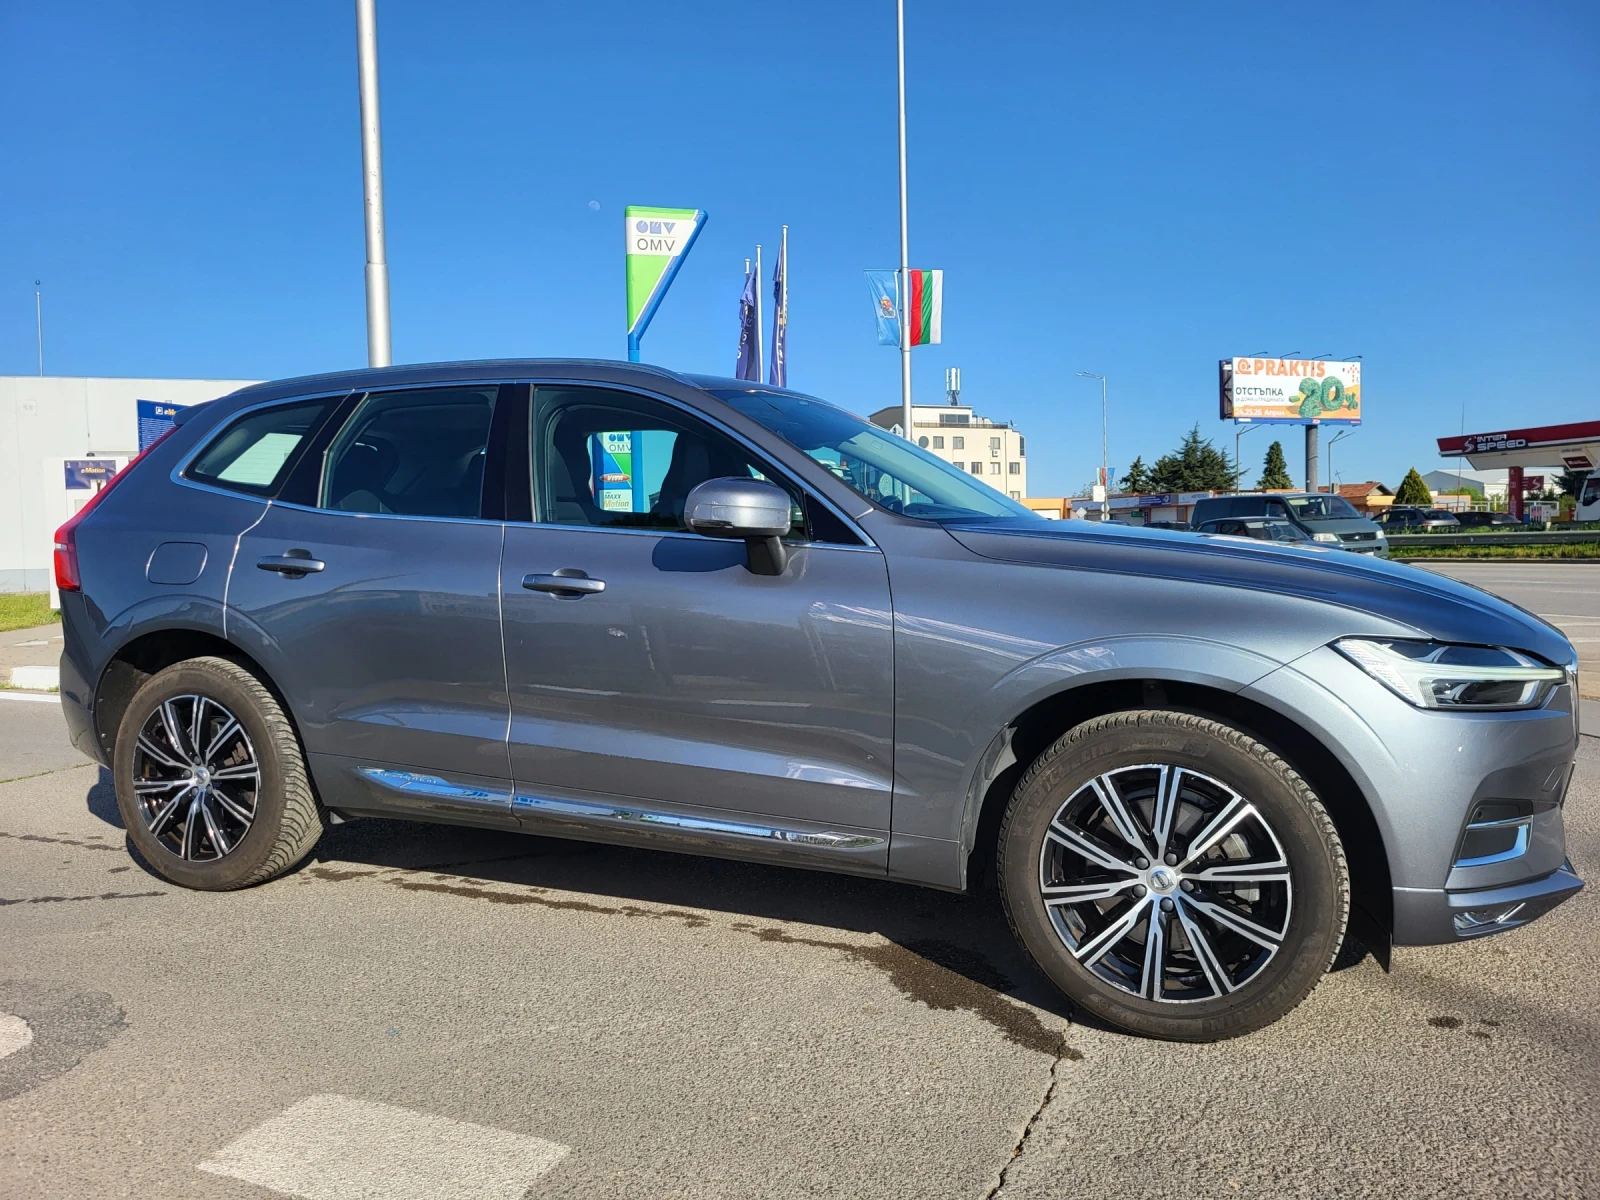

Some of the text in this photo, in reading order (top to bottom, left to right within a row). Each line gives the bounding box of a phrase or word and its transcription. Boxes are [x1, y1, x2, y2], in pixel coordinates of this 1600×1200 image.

[637, 238, 676, 251] OMV
[1253, 359, 1325, 377] PRAKTIS
[1235, 387, 1284, 396] ОТСТЪПКА
[1477, 434, 1507, 442] INTER
[609, 444, 631, 452] OMV
[1477, 439, 1526, 451] SPEED
[603, 500, 629, 508] Motion
